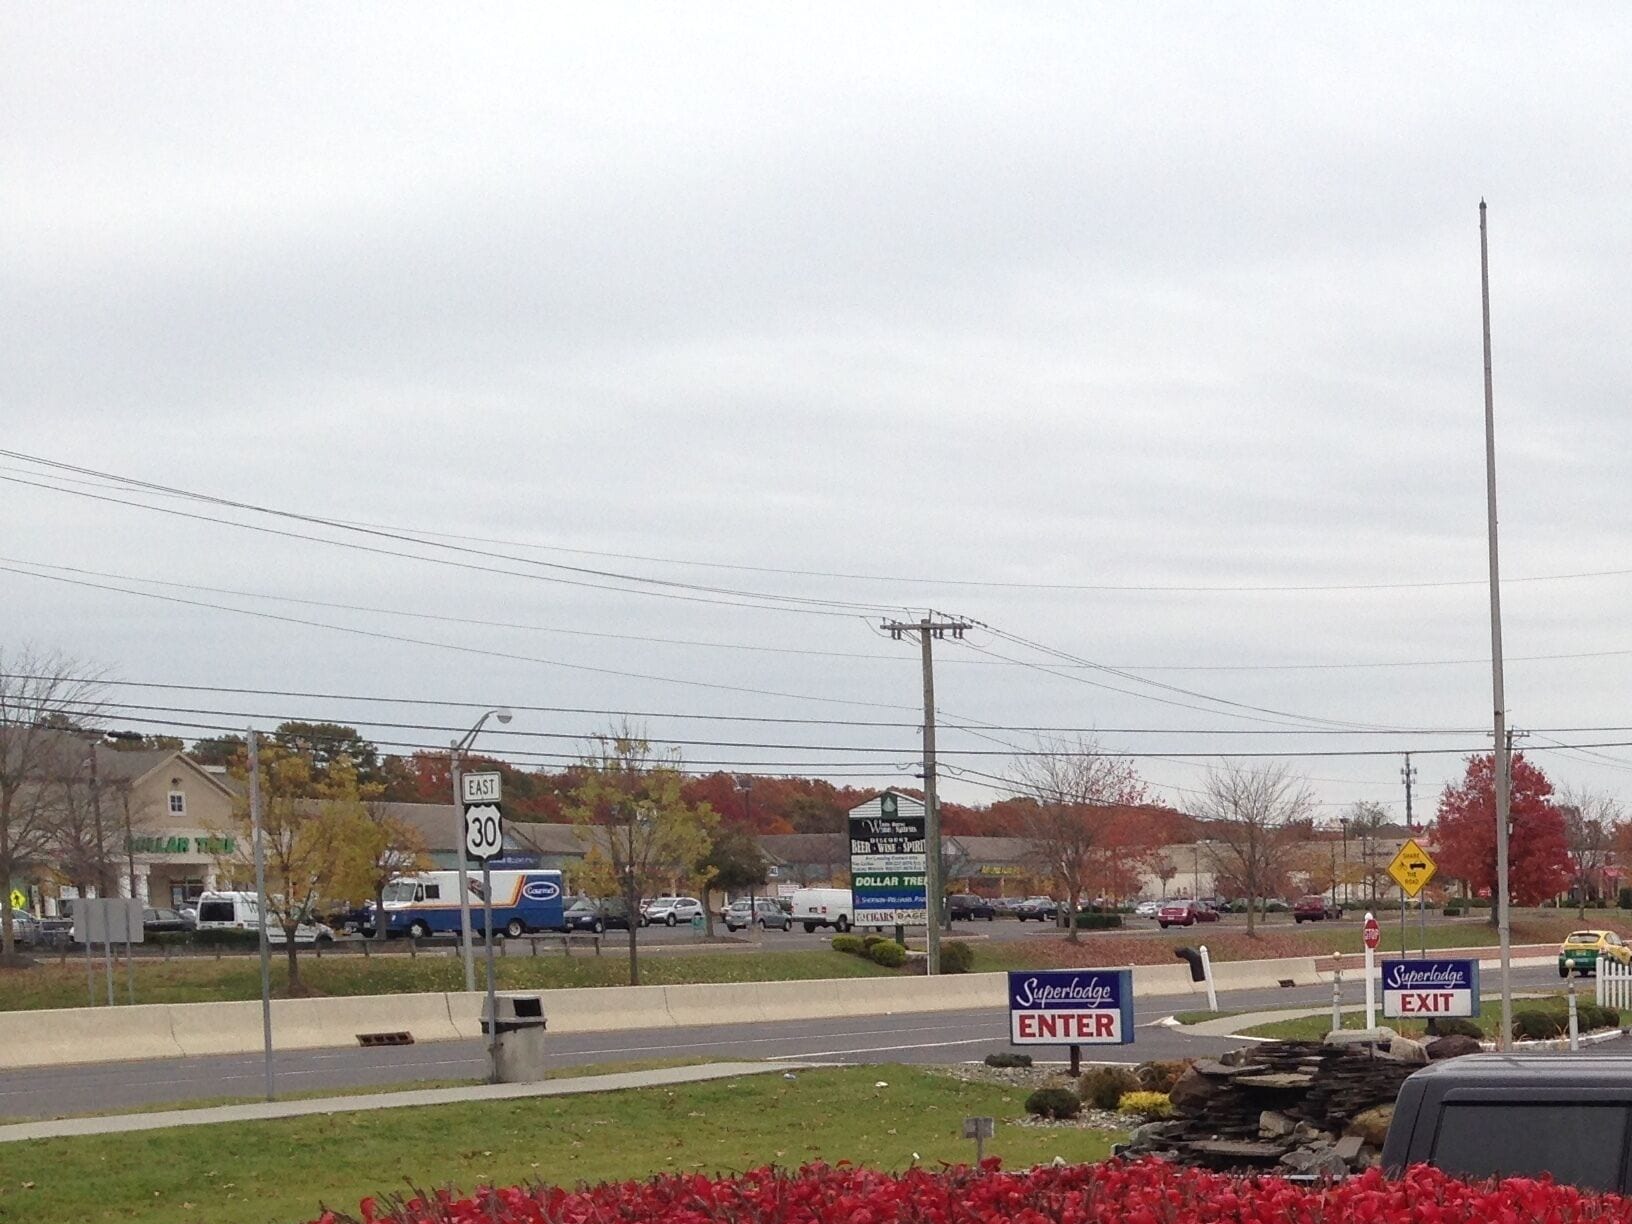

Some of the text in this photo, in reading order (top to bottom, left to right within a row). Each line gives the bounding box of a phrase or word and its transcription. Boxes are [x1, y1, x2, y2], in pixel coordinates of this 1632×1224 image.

[469, 779, 495, 796] EAST
[472, 816, 497, 848] 30
[851, 840, 871, 853] BEER
[877, 843, 897, 853] WINE
[856, 876, 899, 887] DOLLAR
[866, 912, 894, 921] CIGARS
[1364, 929, 1379, 940] STOP
[1387, 963, 1464, 989] Superlodge
[1016, 977, 1112, 1009] Superlodge
[1400, 993, 1454, 1012] EXIT
[1019, 1013, 1114, 1038] ENTER
